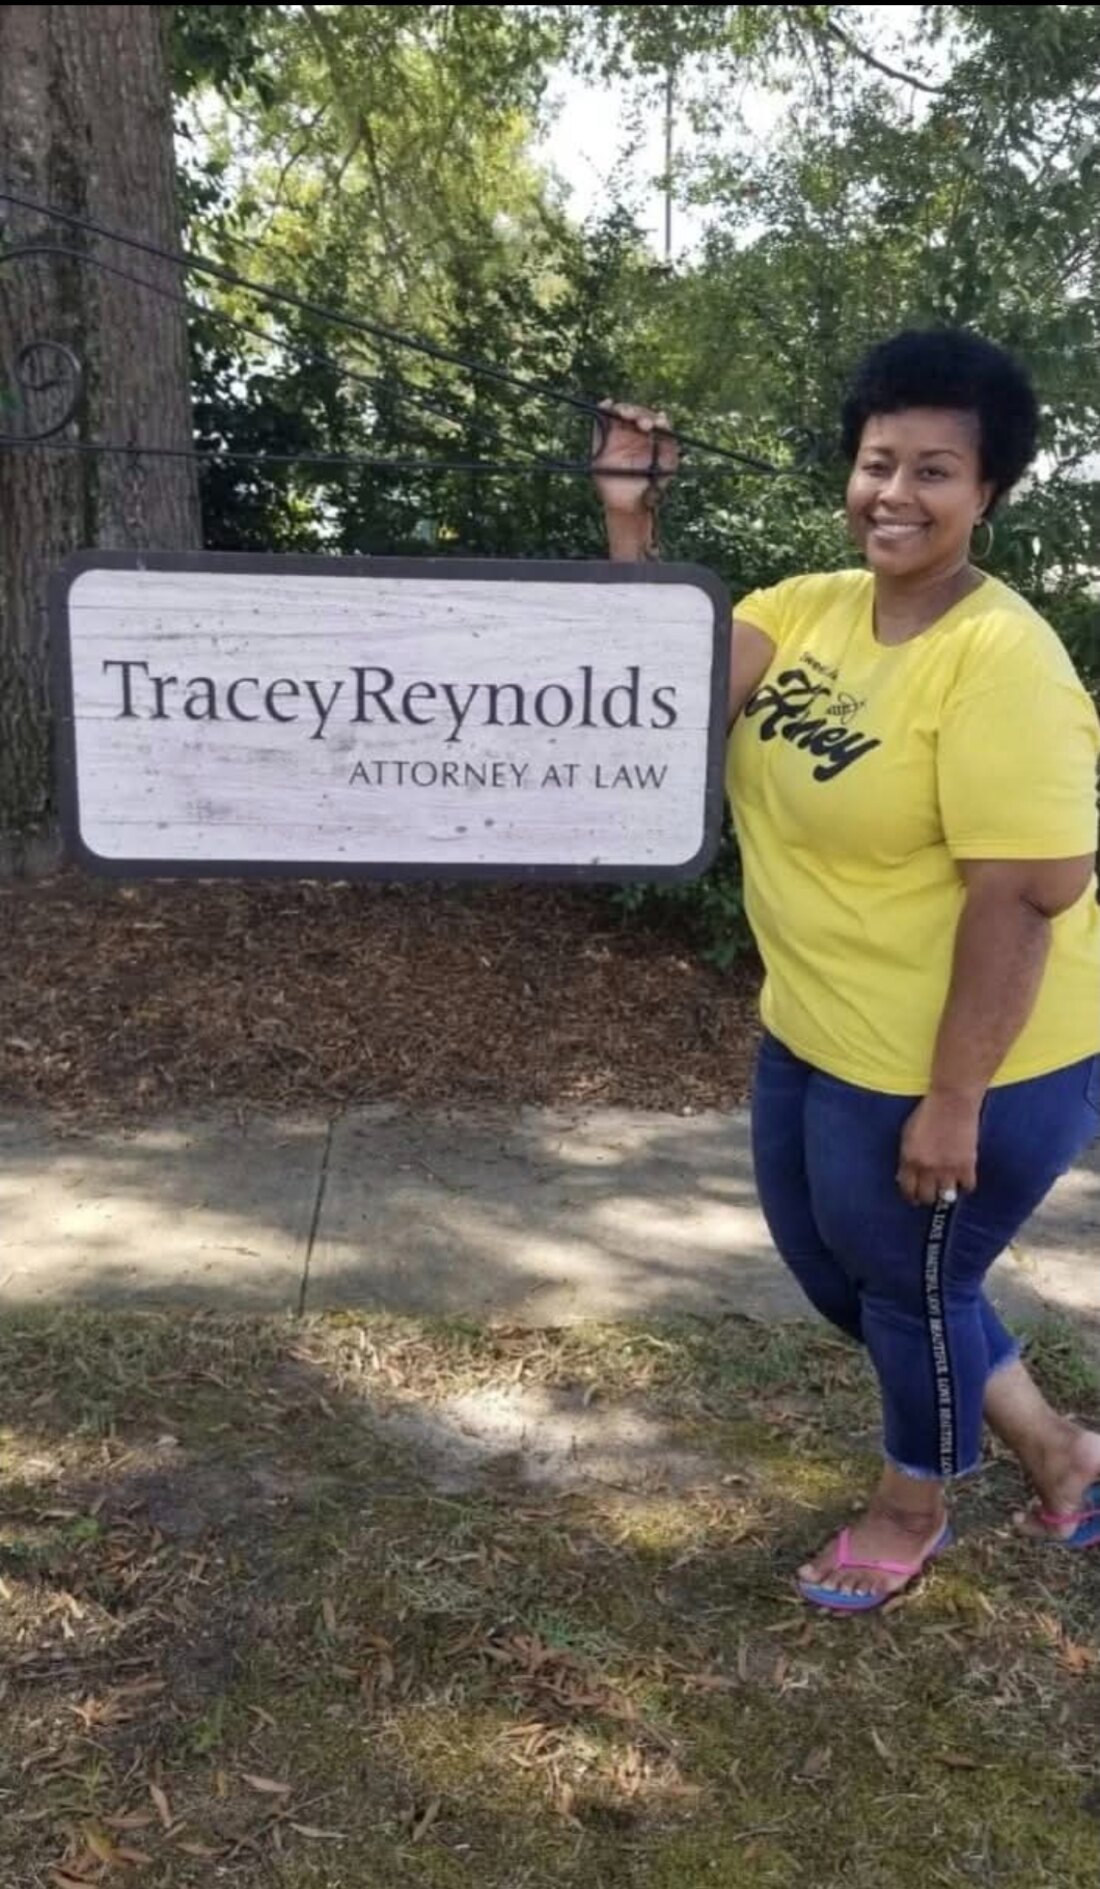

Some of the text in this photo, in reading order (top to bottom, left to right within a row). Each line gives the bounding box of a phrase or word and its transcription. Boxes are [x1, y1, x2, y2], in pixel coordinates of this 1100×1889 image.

[348, 759, 668, 790] ATTORNEY AT LAW
[930, 1318, 949, 1374] BEAUTIFUL
[937, 1377, 951, 1405] LOVE
